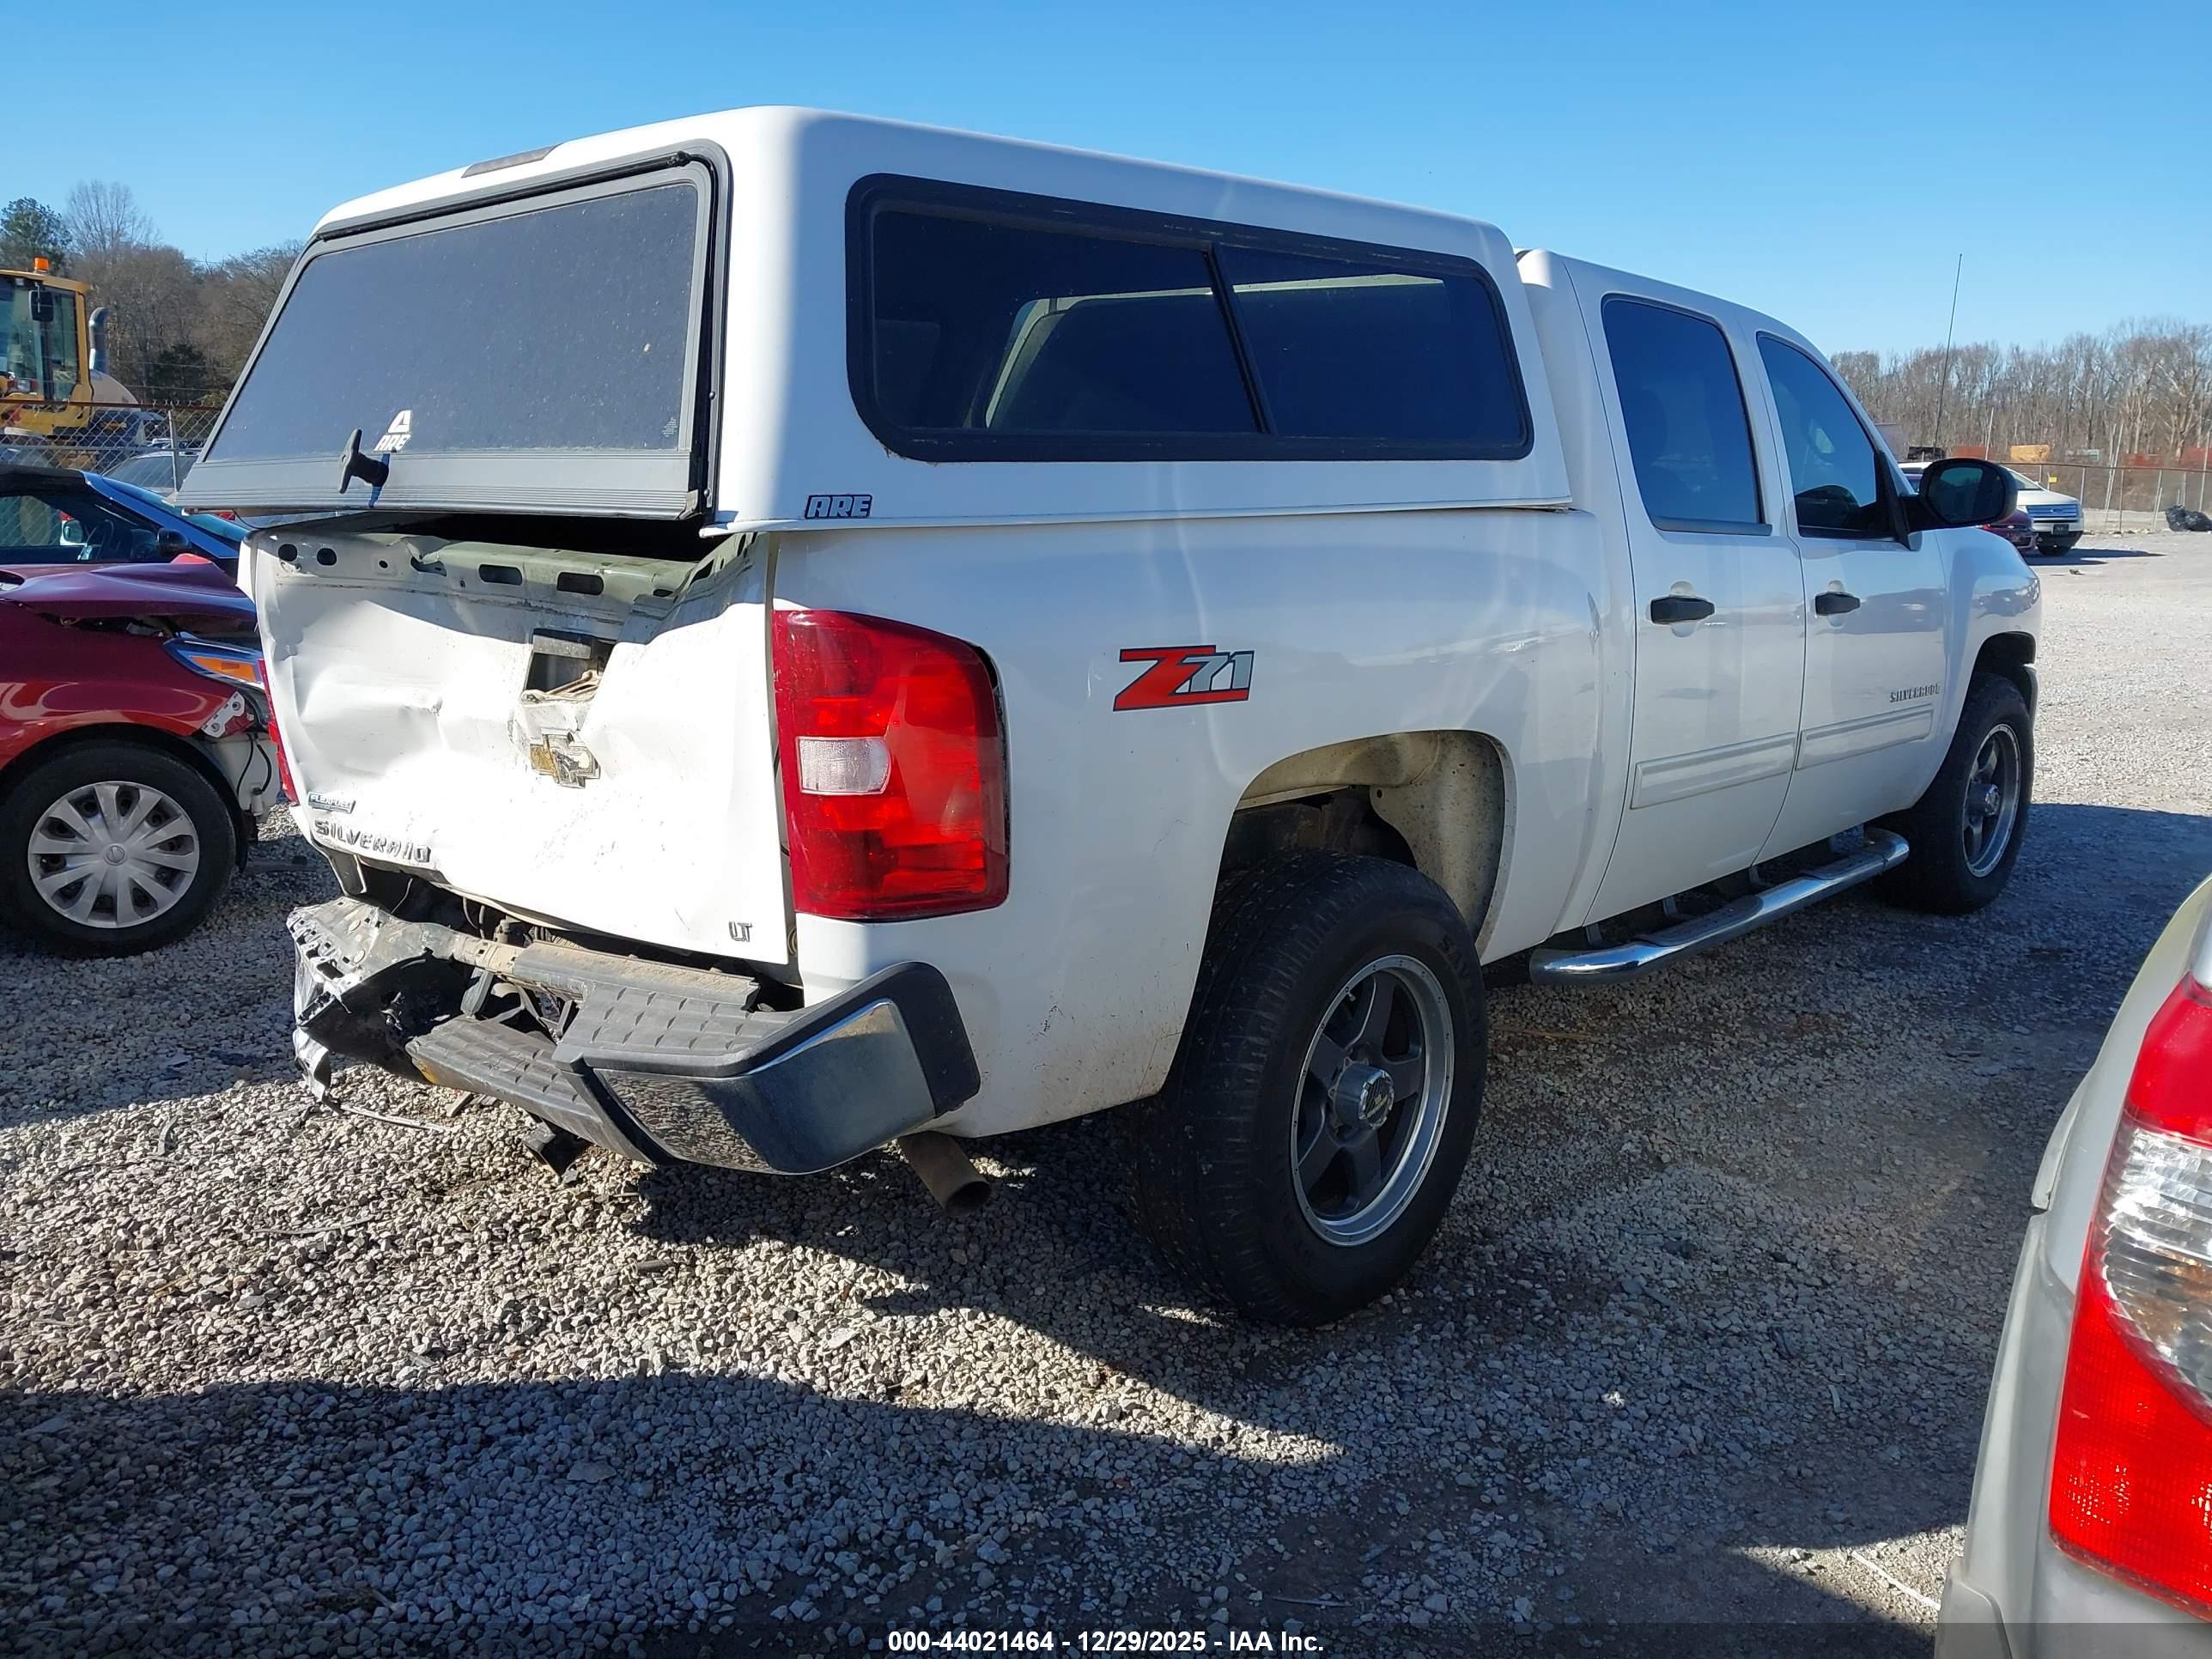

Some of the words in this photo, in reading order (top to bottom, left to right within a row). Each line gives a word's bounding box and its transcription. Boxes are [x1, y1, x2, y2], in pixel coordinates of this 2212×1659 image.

[805, 494, 873, 520] ARE
[1112, 644, 1255, 712] Z71
[728, 921, 753, 943] LT
